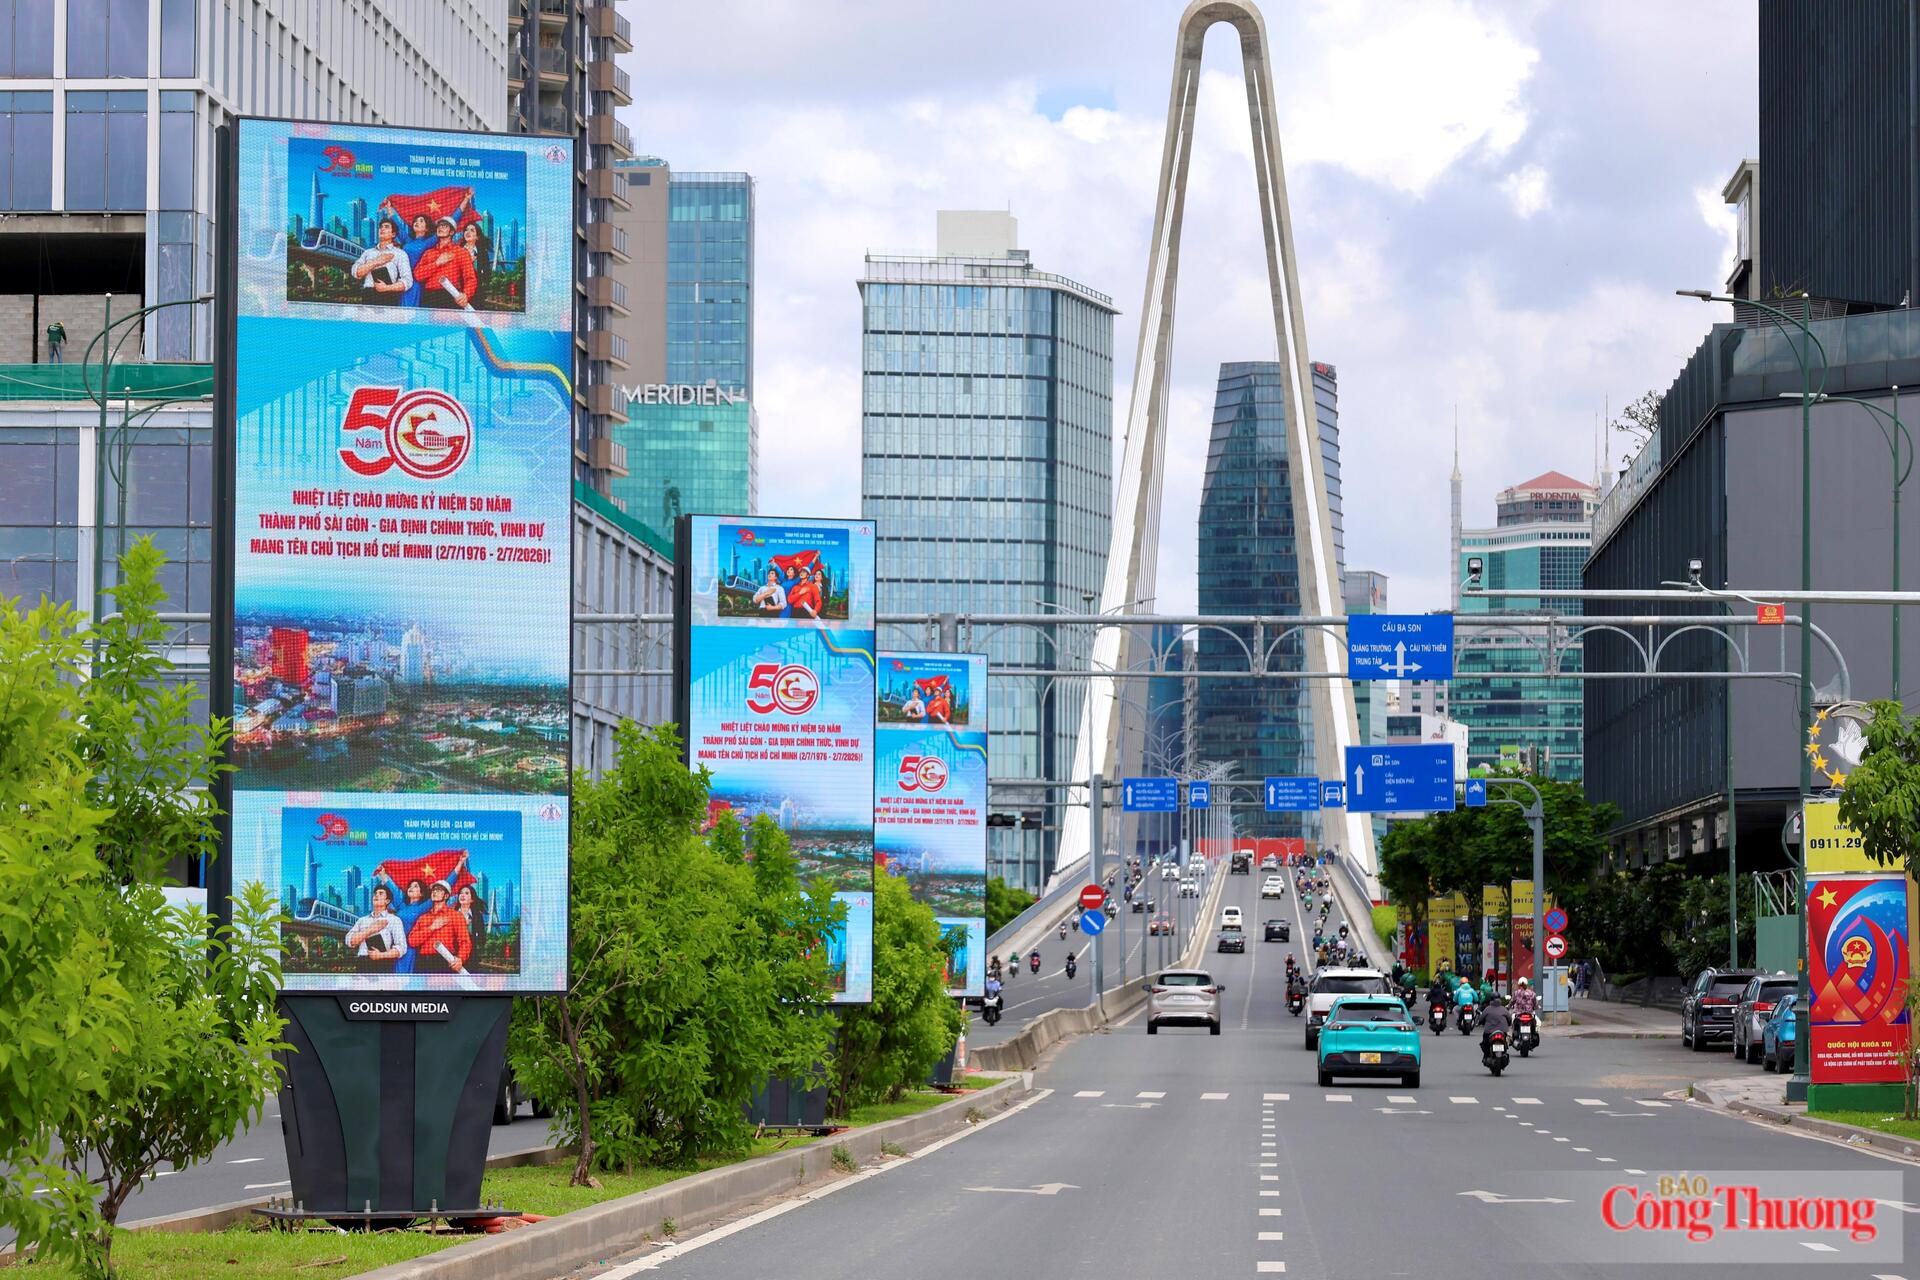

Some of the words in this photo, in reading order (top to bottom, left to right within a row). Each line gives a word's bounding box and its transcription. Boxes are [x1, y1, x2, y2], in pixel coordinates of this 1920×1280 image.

[622, 384, 733, 406] MERIDIEN
[340, 388, 470, 478] 50
[356, 437, 382, 449] Năm
[293, 488, 324, 508] NHIỆT
[328, 489, 350, 510] LIỆT
[353, 490, 382, 508] CHÀO
[386, 491, 418, 509] MỪNG
[422, 491, 435, 509] KỶ
[439, 493, 466, 513] NIỆM
[470, 498, 482, 512] 50
[486, 495, 511, 512] NĂM
[1530, 492, 1581, 500] PRUDENTIAL
[259, 512, 295, 529] THÀNH
[299, 511, 321, 530] PHỐ
[324, 514, 342, 531] SÀI
[346, 514, 368, 532] GÒN
[380, 519, 398, 533] GIA
[401, 519, 426, 536] ĐỊNH
[430, 518, 464, 535] CHÍNH
[467, 519, 497, 537] THỨC,
[501, 522, 526, 537] VINH
[529, 522, 544, 541] DỰ
[250, 539, 284, 554] MANG
[288, 538, 308, 554] TÊN
[311, 536, 333, 555] CHỦ
[337, 542, 360, 559] TỊCH
[364, 538, 378, 557] HỒ
[382, 541, 400, 558] CHÍ
[404, 544, 432, 559] MINH
[436, 545, 486, 561] (2/7/1976
[497, 548, 551, 564] 2/7/2026)!
[1408, 624, 1421, 632] SON
[721, 722, 739, 733] NHIỆT
[740, 723, 752, 734] LIỆT
[754, 723, 770, 732] CHÀO
[772, 723, 790, 732] MỪNG
[791, 722, 799, 732] KỶ
[801, 724, 816, 734] NIỆM
[827, 724, 841, 733] NĂM
[350, 1002, 407, 1013] GOLDSUN
[411, 1002, 449, 1013] MEDIA
